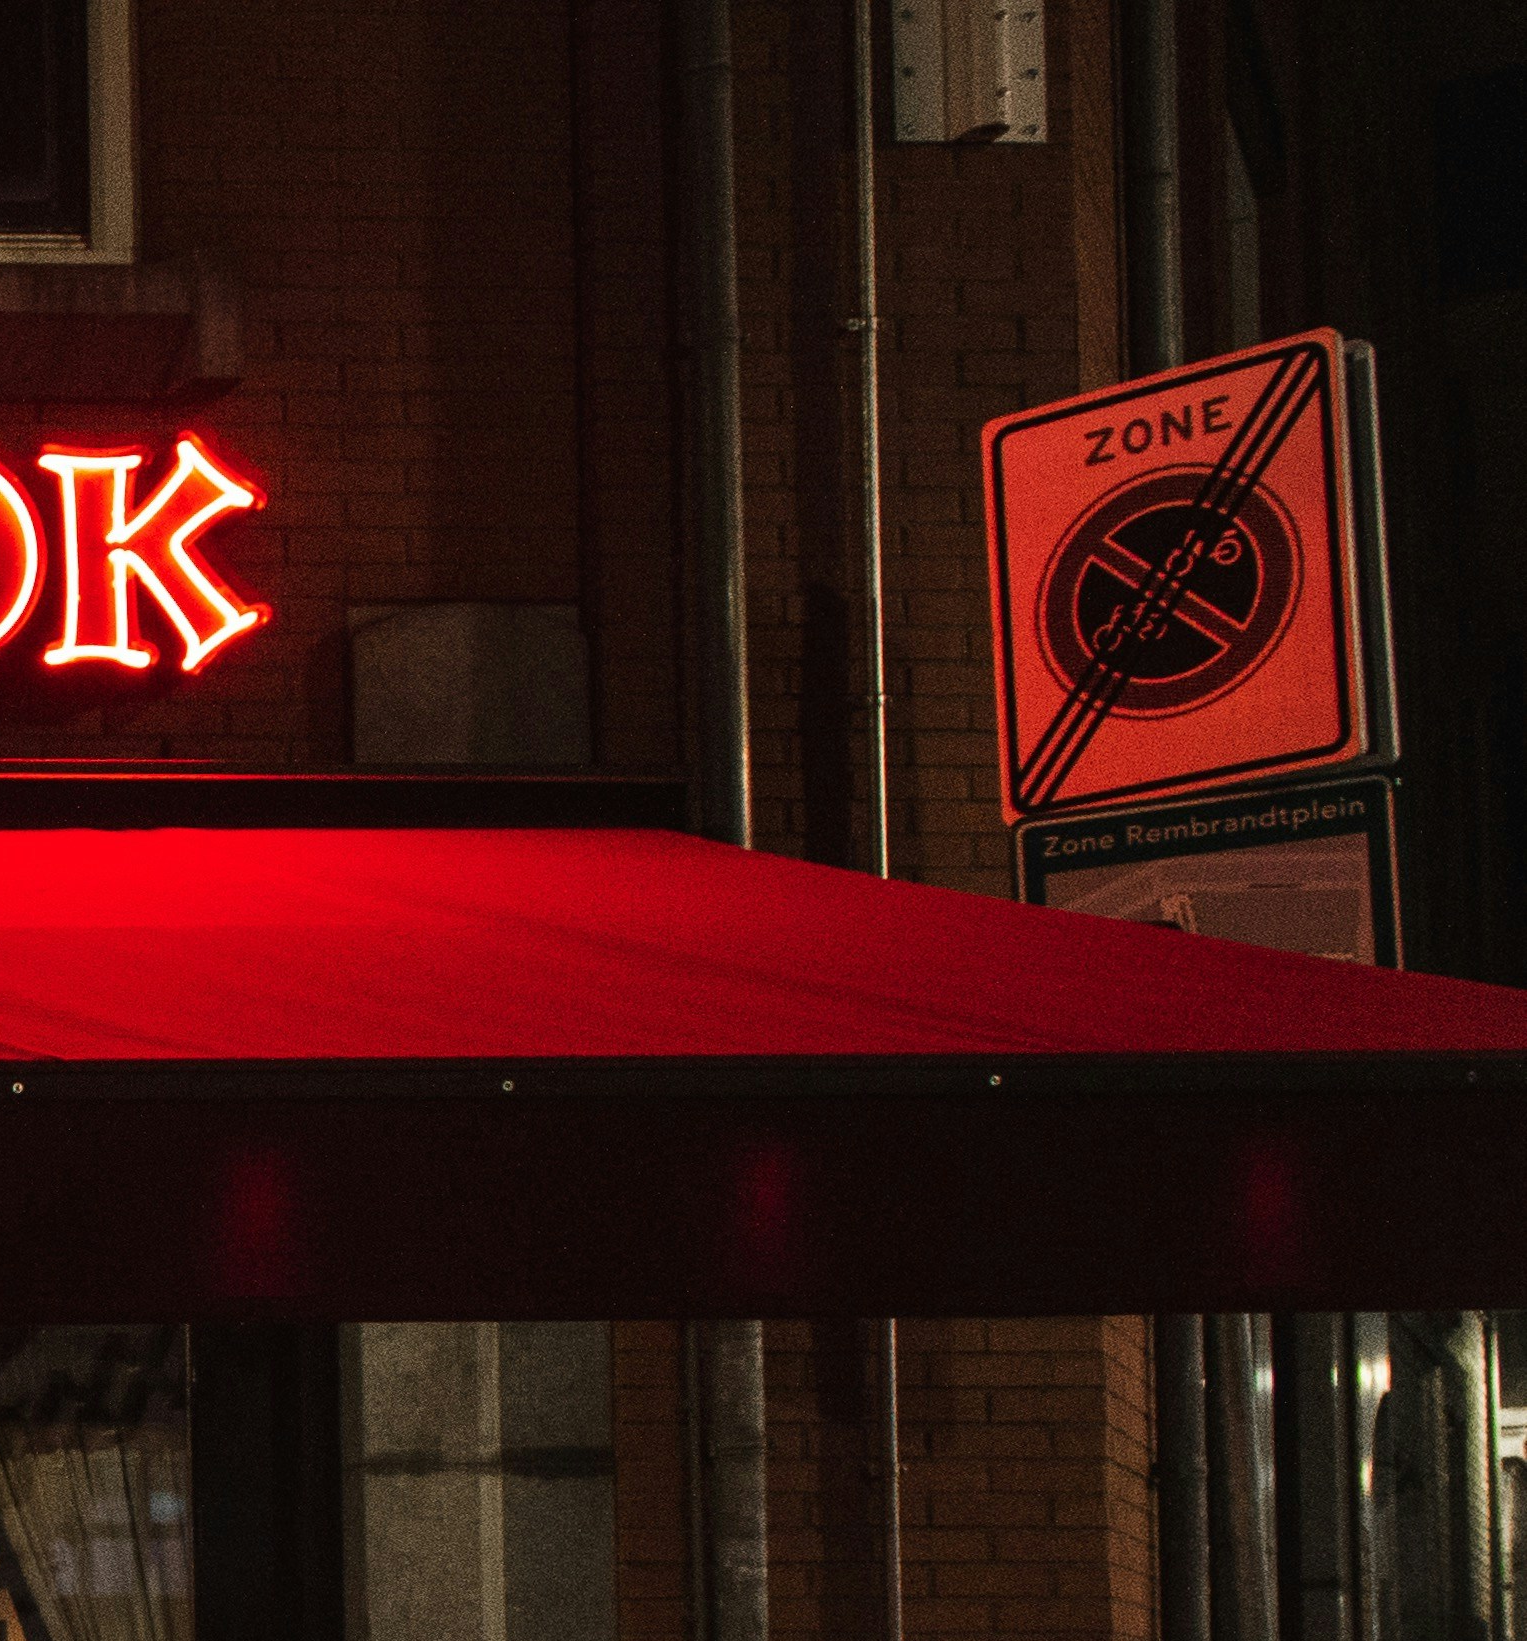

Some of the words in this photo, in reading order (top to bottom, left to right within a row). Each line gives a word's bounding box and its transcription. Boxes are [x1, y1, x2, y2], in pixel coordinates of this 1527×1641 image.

[1084, 396, 1232, 466] ZONE
[1043, 831, 1116, 859] Zone
[1126, 797, 1366, 846] Rembrandtplein
